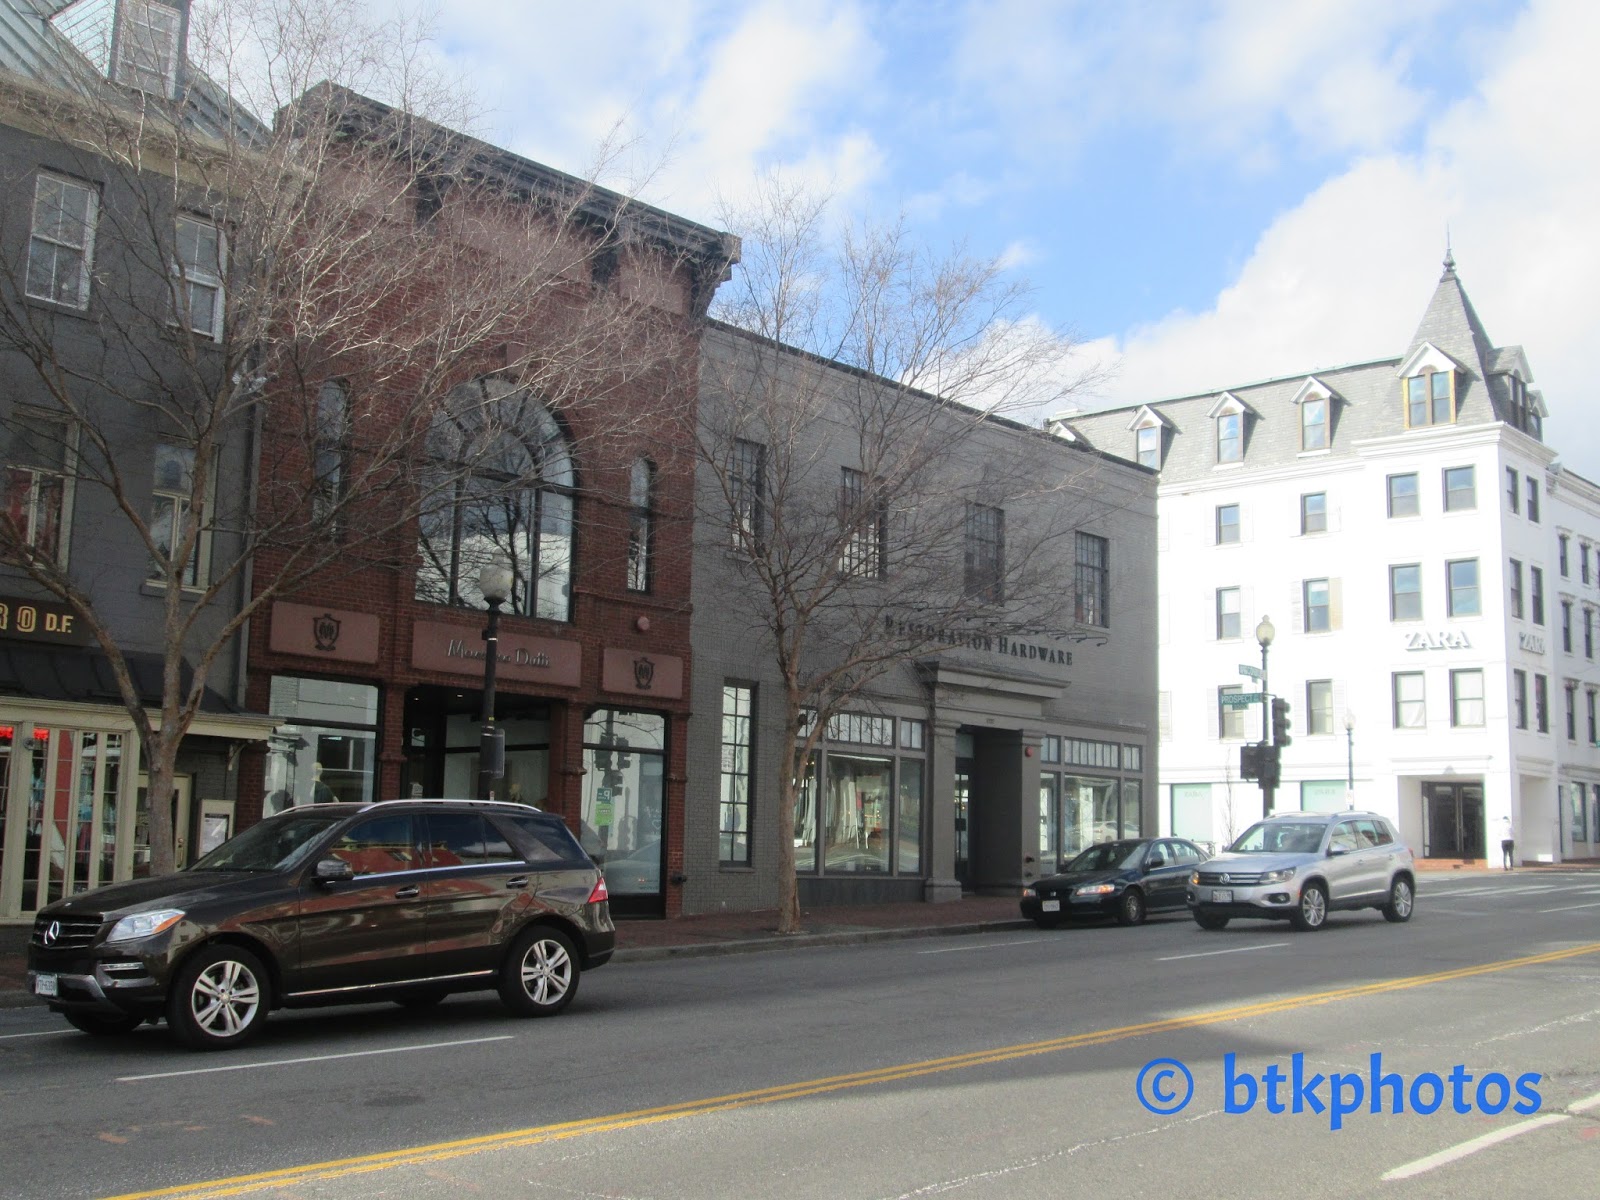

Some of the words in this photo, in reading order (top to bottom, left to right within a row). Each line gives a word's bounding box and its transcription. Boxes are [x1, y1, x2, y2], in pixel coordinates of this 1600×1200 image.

[45, 613, 74, 633] D.F.
[1405, 631, 1472, 651] ZARA
[999, 637, 1073, 666] HARDWARE
[1222, 694, 1252, 704] PROSPECT
